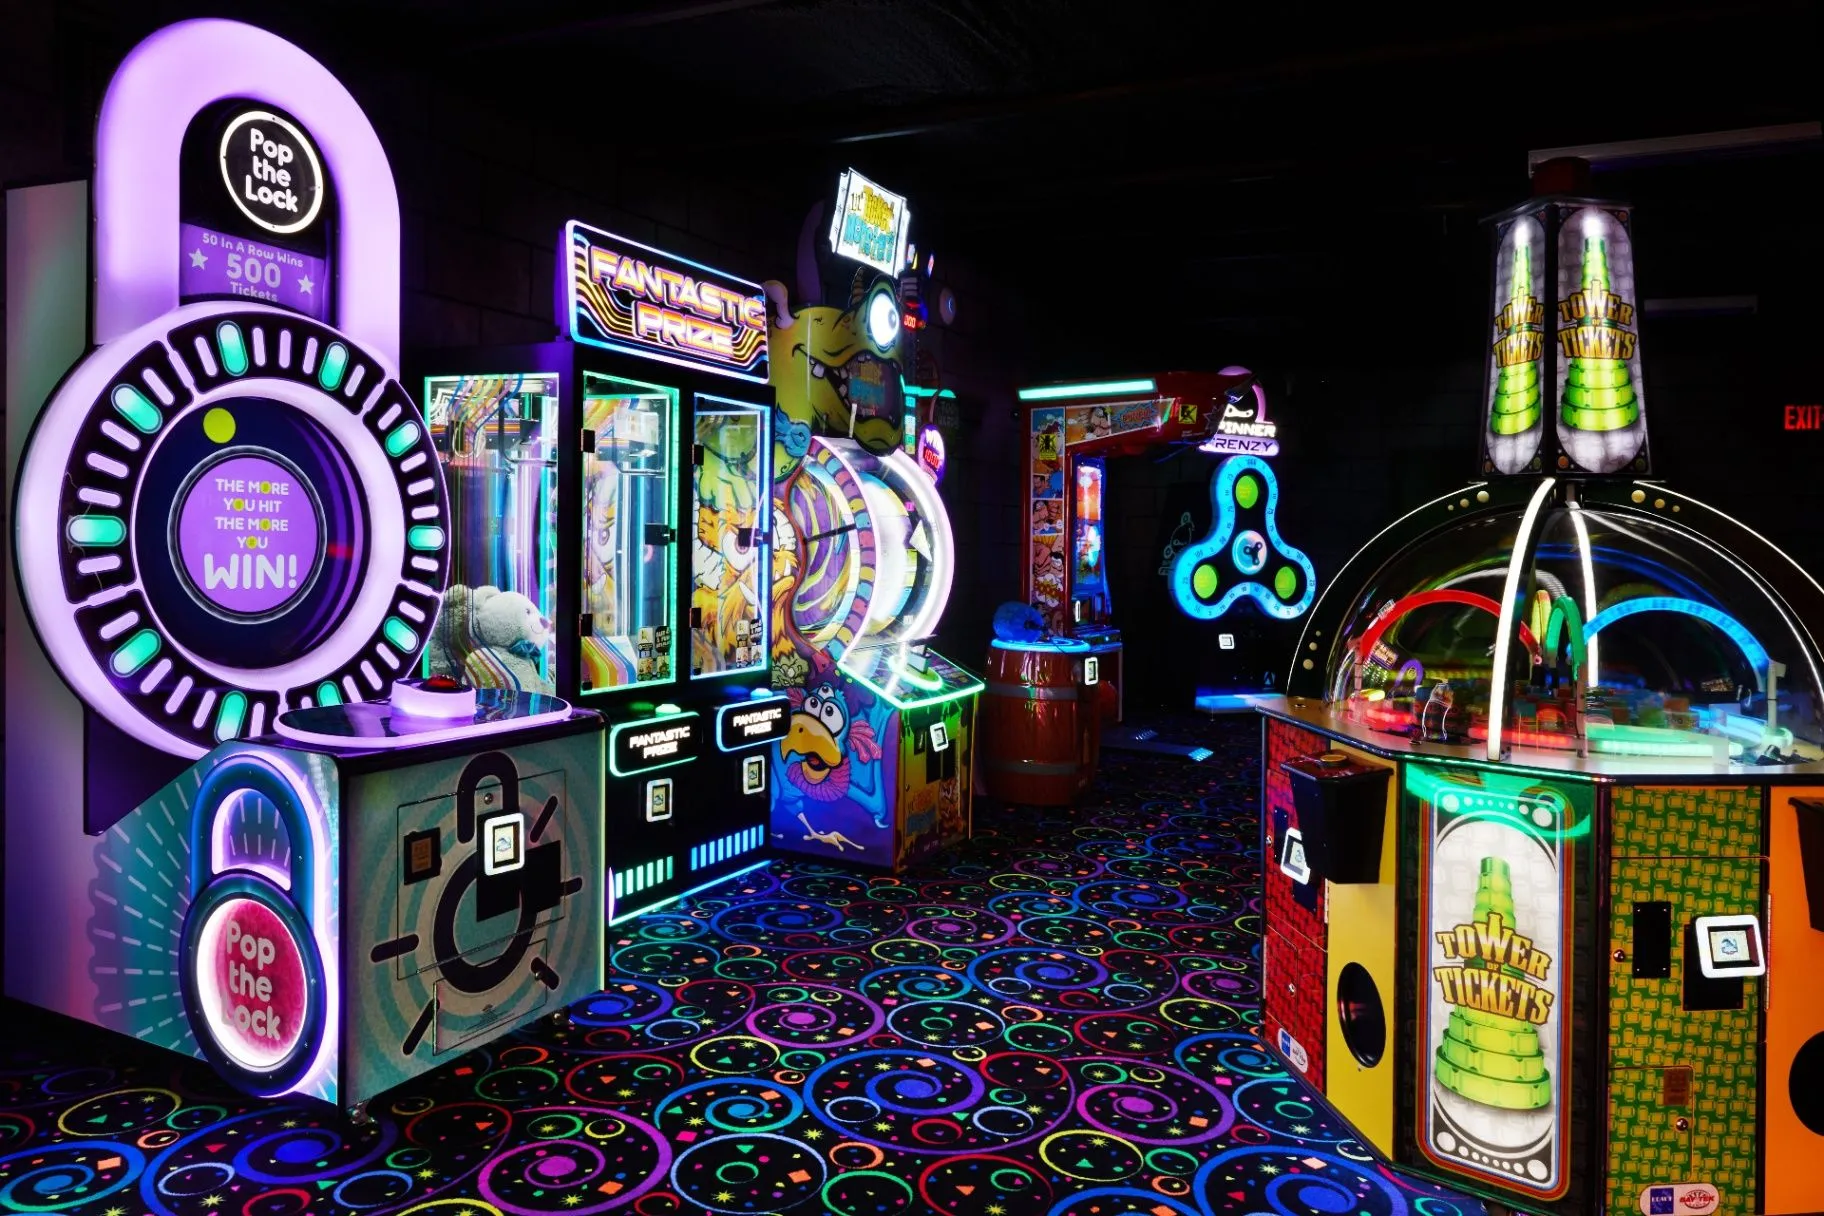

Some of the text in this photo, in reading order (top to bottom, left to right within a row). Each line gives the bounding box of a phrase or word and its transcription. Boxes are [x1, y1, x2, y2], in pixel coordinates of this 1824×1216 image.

[251, 128, 293, 166] Pop
[253, 155, 291, 187] the
[246, 175, 298, 212] Lock
[202, 233, 303, 268] 50 In A Row Wins
[226, 253, 281, 288] 500
[589, 245, 765, 331] FANTASTIC
[230, 281, 278, 302] Tickets
[1558, 279, 1634, 325] TOWER
[1494, 287, 1544, 334] TOWER
[634, 301, 734, 357] PRIZE
[1558, 326, 1637, 360] TICKETS
[1493, 331, 1544, 368] TICKETS
[1784, 405, 1821, 430] EXIT
[1214, 438, 1273, 452] RENZY
[216, 479, 289, 495] THE MORE
[223, 497, 282, 513] YOU HIT
[215, 516, 289, 531] THE MORE
[236, 535, 268, 549] YOU
[204, 553, 297, 590] WIN!
[732, 708, 782, 728] FANTASTIC
[629, 726, 691, 749] FANTASTIC
[226, 919, 275, 970] Pop
[1435, 911, 1552, 981] TOWER
[229, 960, 272, 1002] the
[1433, 966, 1554, 1025] TICKETS
[221, 994, 281, 1041] Lock
